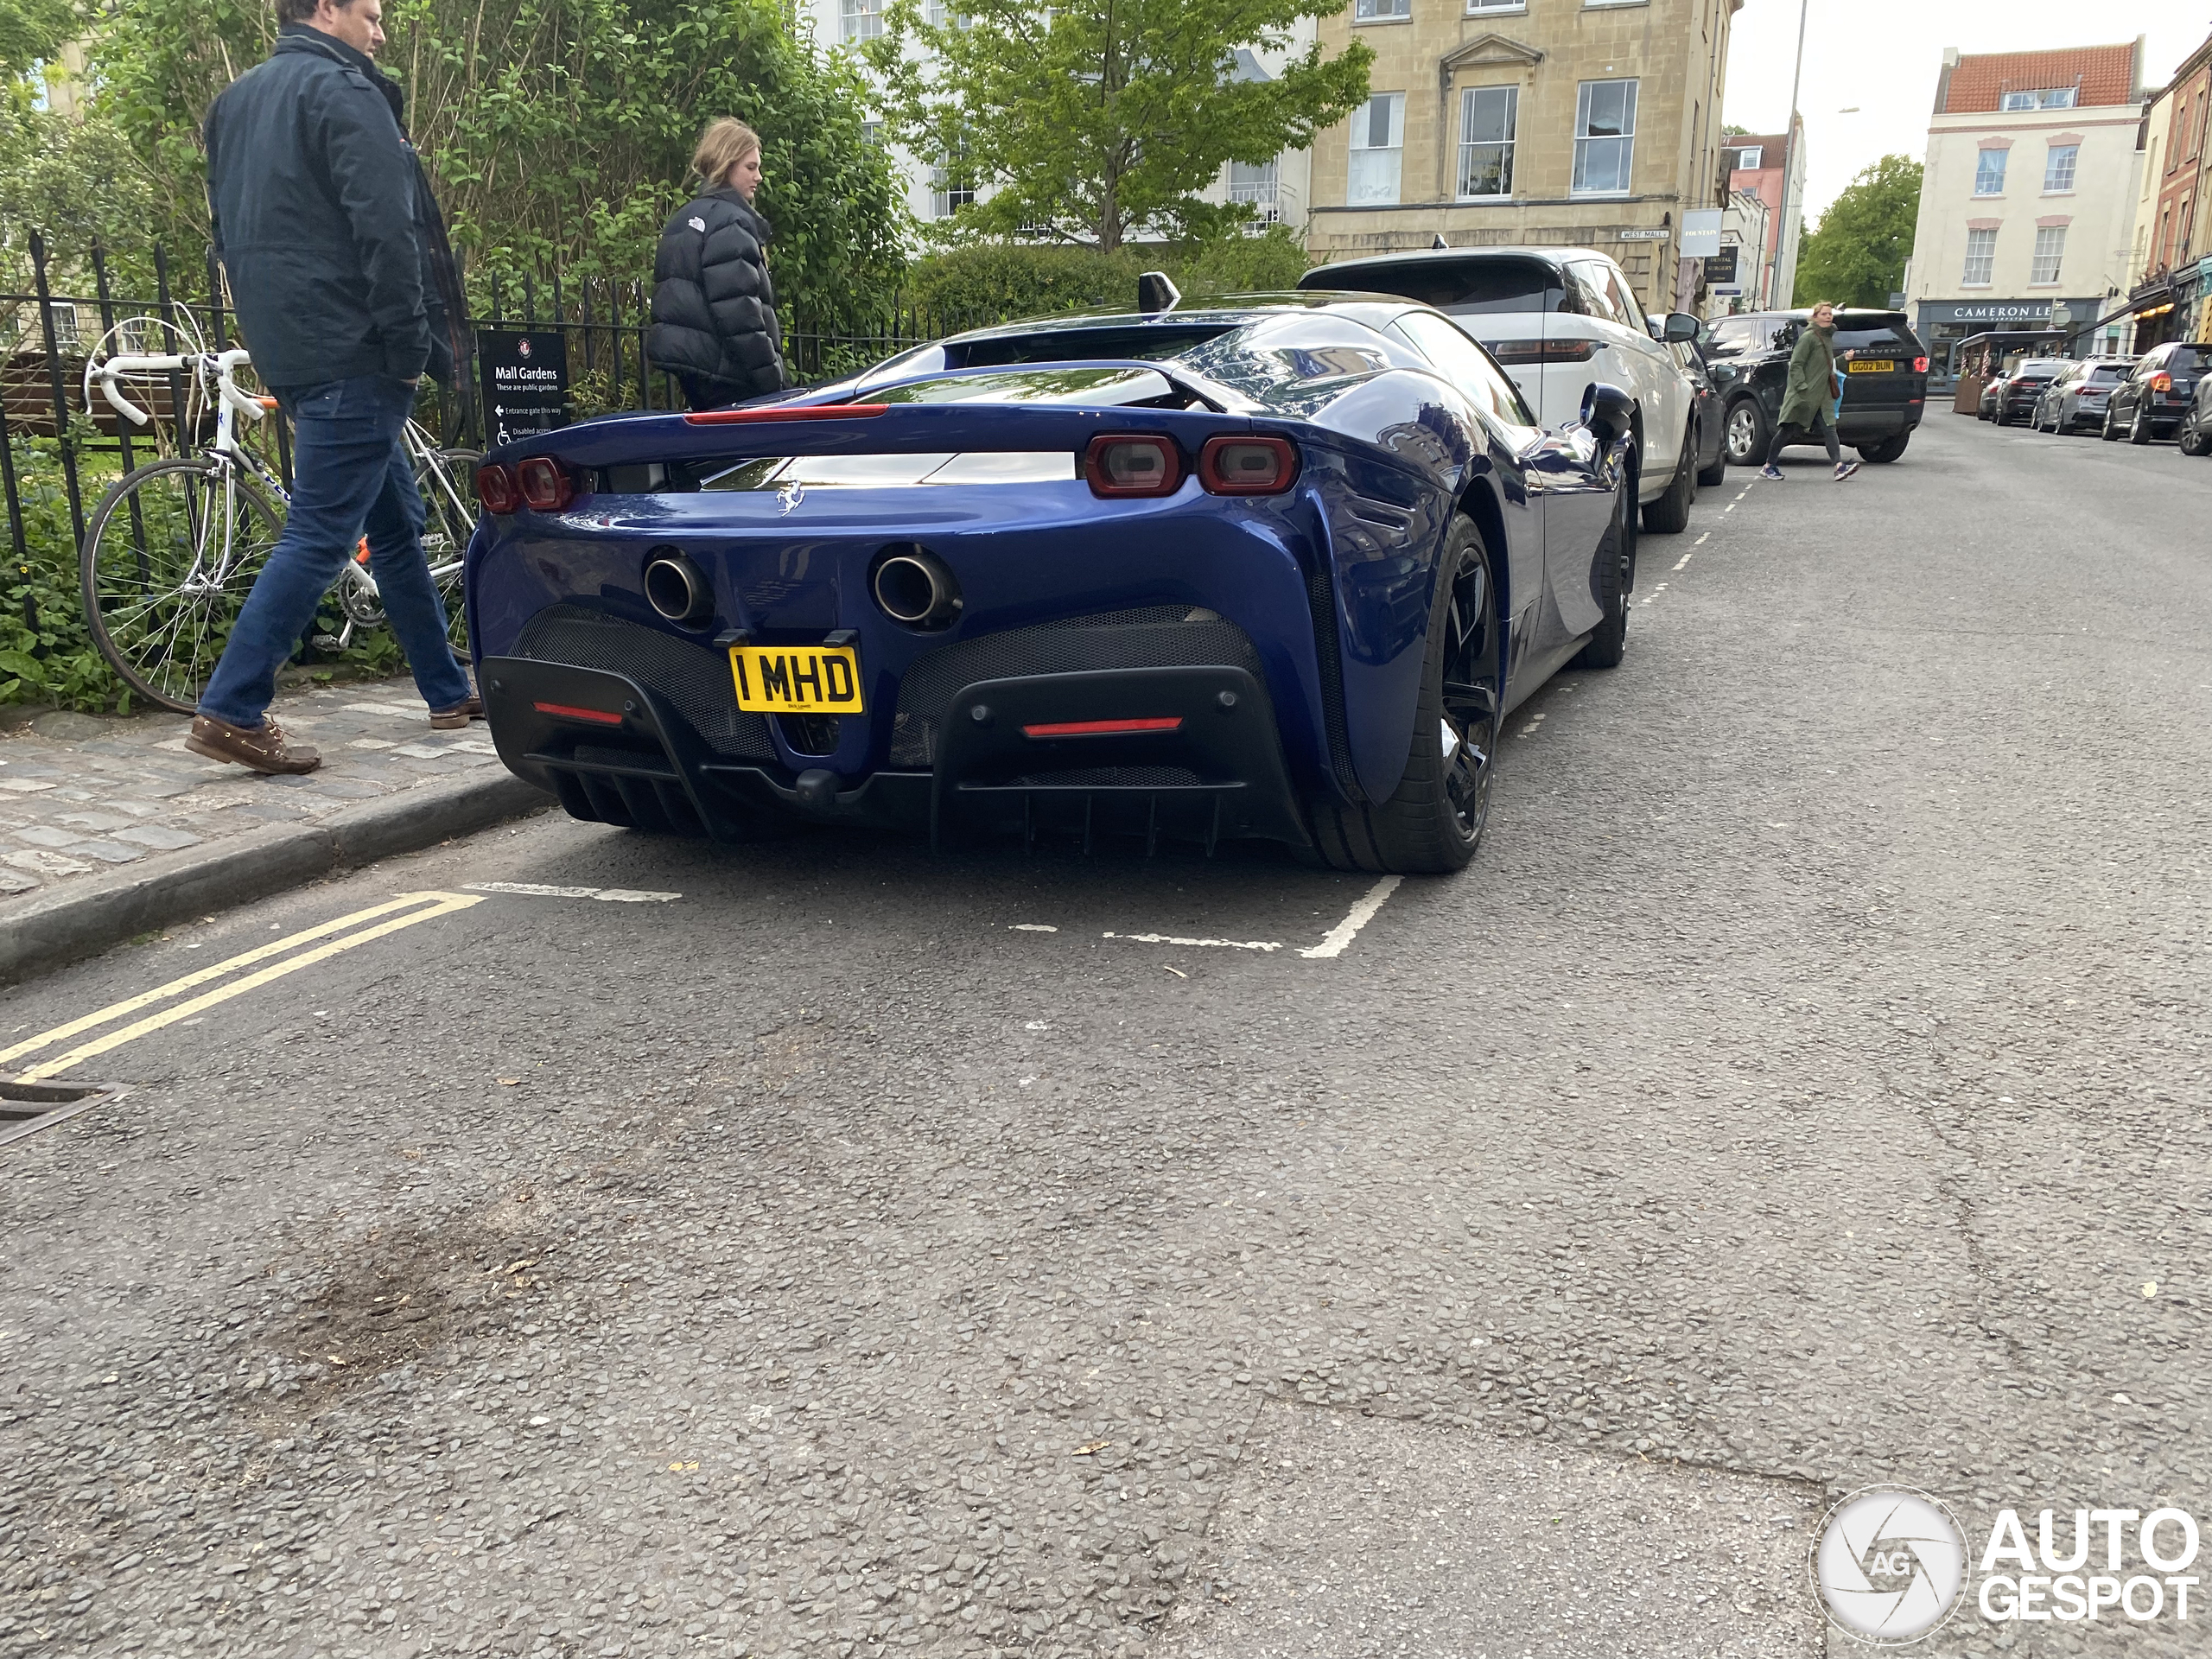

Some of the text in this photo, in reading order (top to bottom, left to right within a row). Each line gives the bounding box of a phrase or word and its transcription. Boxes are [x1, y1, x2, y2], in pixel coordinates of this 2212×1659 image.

[1955, 307, 2030, 317] CAMERON
[1876, 361, 1891, 371] BUN
[495, 366, 557, 380] Mall Gardens
[523, 384, 537, 392] public
[759, 654, 855, 702] MHD
